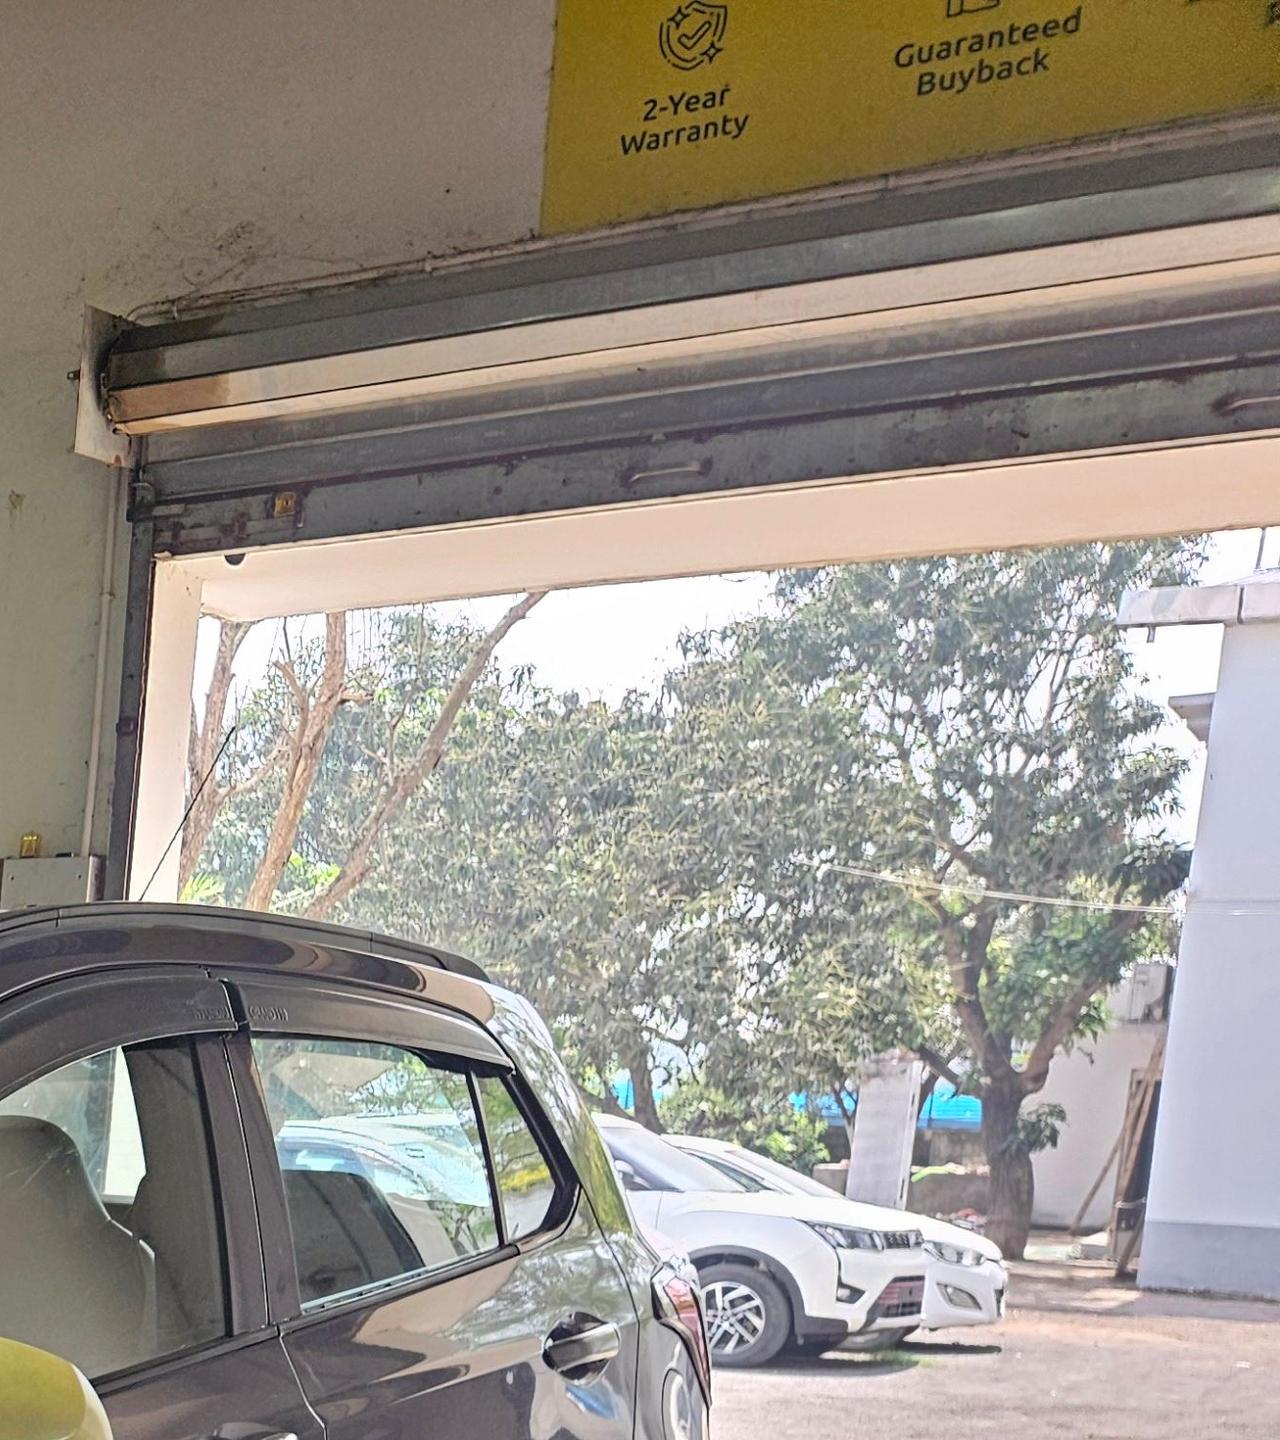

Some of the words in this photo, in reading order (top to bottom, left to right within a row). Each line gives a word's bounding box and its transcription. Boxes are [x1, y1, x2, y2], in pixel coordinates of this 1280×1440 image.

[894, 5, 1082, 68] Guaranteed
[917, 48, 1050, 95] Buyback
[643, 86, 731, 122] 2-Year
[620, 114, 750, 155] Warranty
